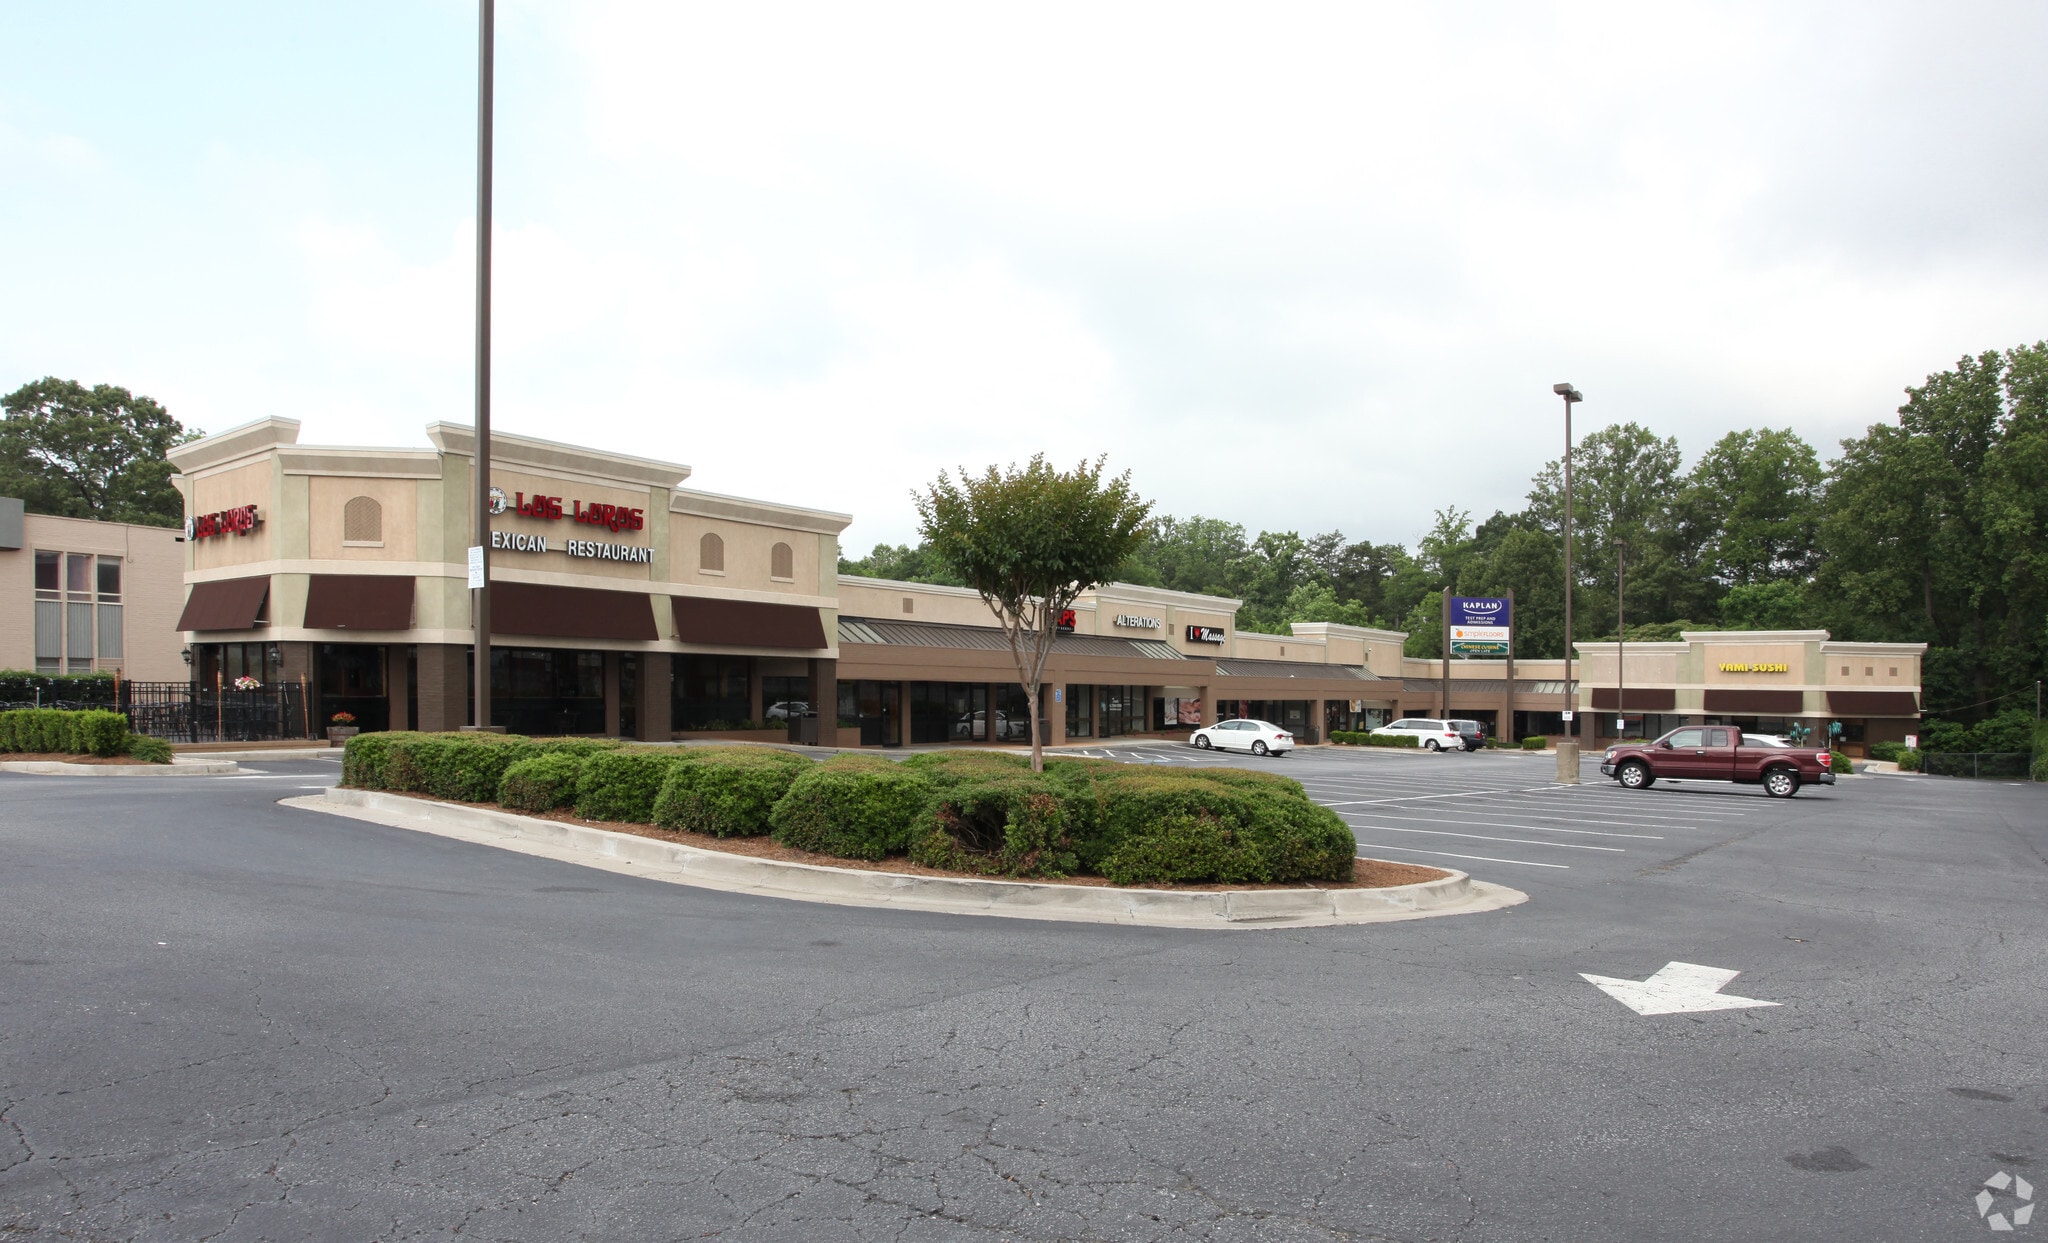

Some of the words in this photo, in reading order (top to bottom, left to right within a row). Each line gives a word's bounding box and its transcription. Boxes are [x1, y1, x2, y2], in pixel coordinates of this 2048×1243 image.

[491, 531, 547, 553] EXICAN
[568, 539, 655, 563] RESTAURANT
[1116, 614, 1161, 629] ALTERATIONS
[1190, 626, 1194, 640] I
[1719, 663, 1749, 672] YAMI
[1751, 663, 1788, 673] SUSHI
